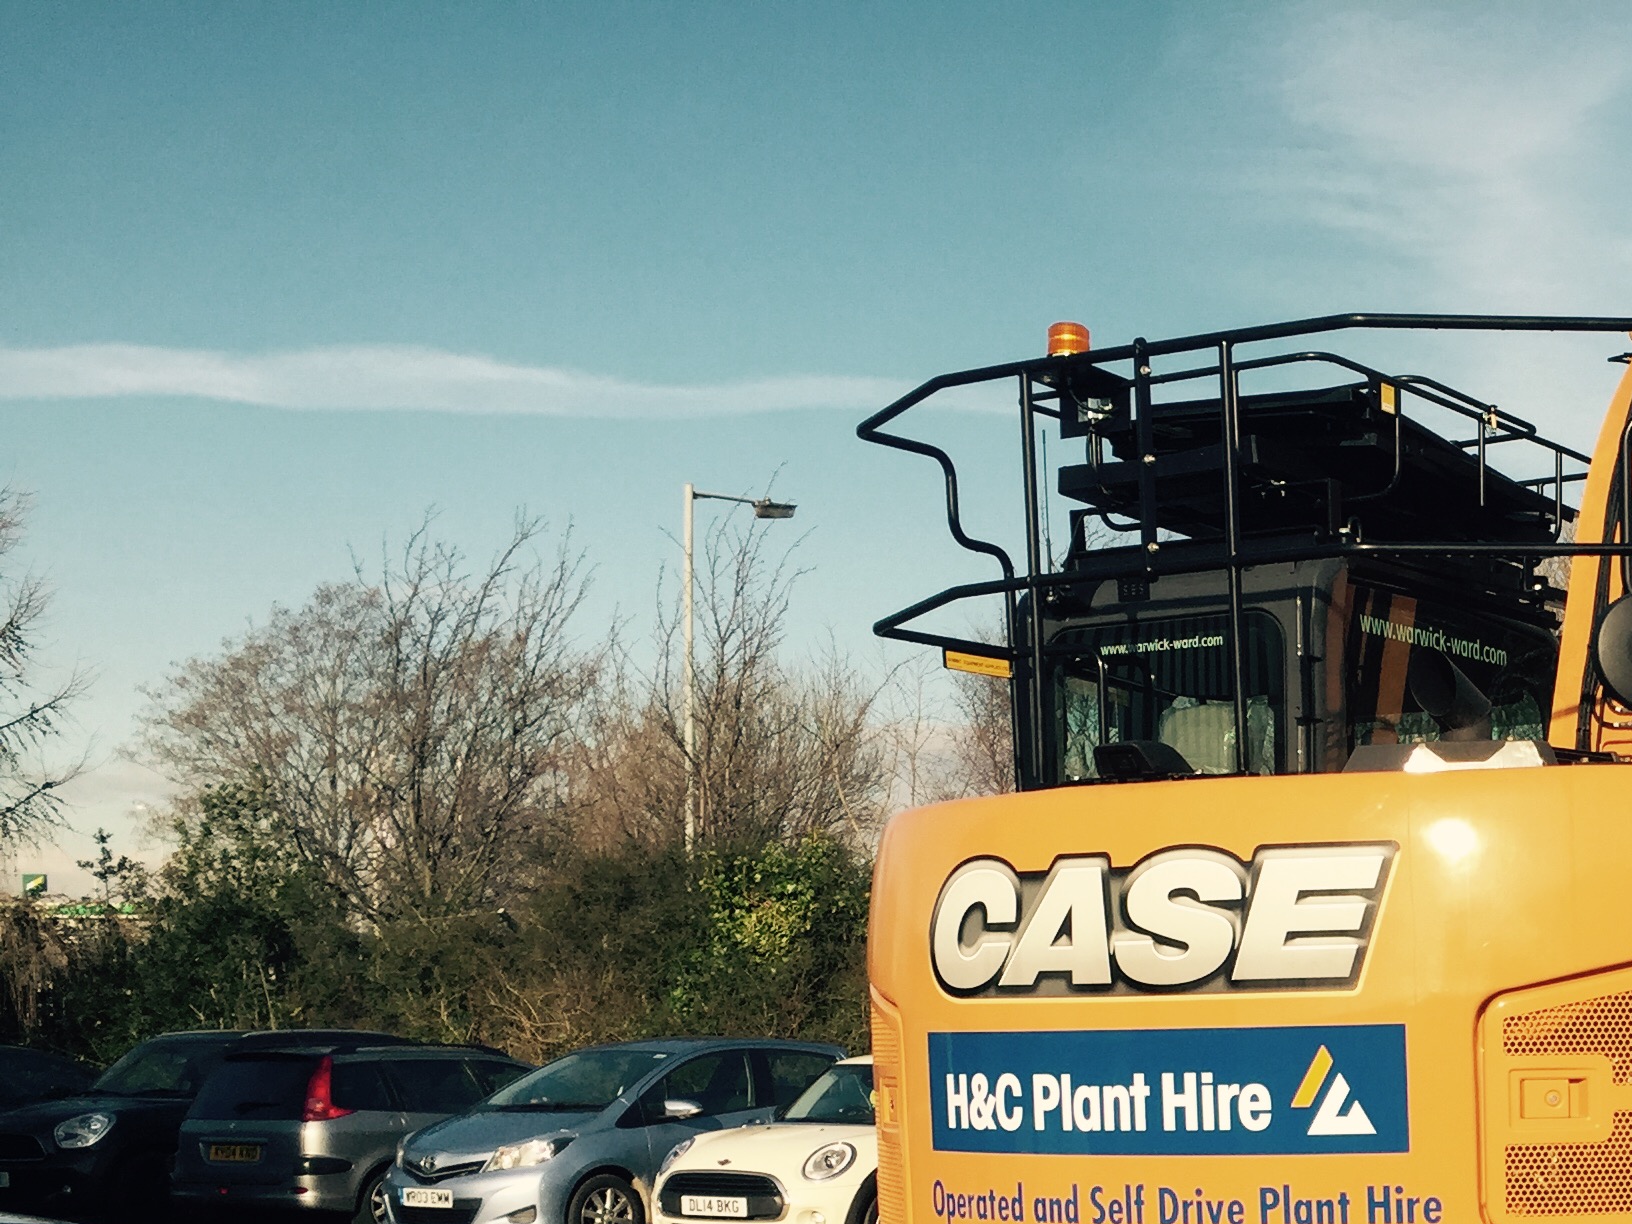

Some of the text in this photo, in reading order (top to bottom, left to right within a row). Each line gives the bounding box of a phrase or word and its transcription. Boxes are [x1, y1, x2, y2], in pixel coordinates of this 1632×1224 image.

[1360, 613, 1508, 667] www.warwick-ward.com
[931, 844, 1397, 994] CASE
[946, 1072, 1273, 1132] H&C Plant Hire
[689, 1198, 740, 1213] DL14 BKG
[1034, 1184, 1080, 1224] and
